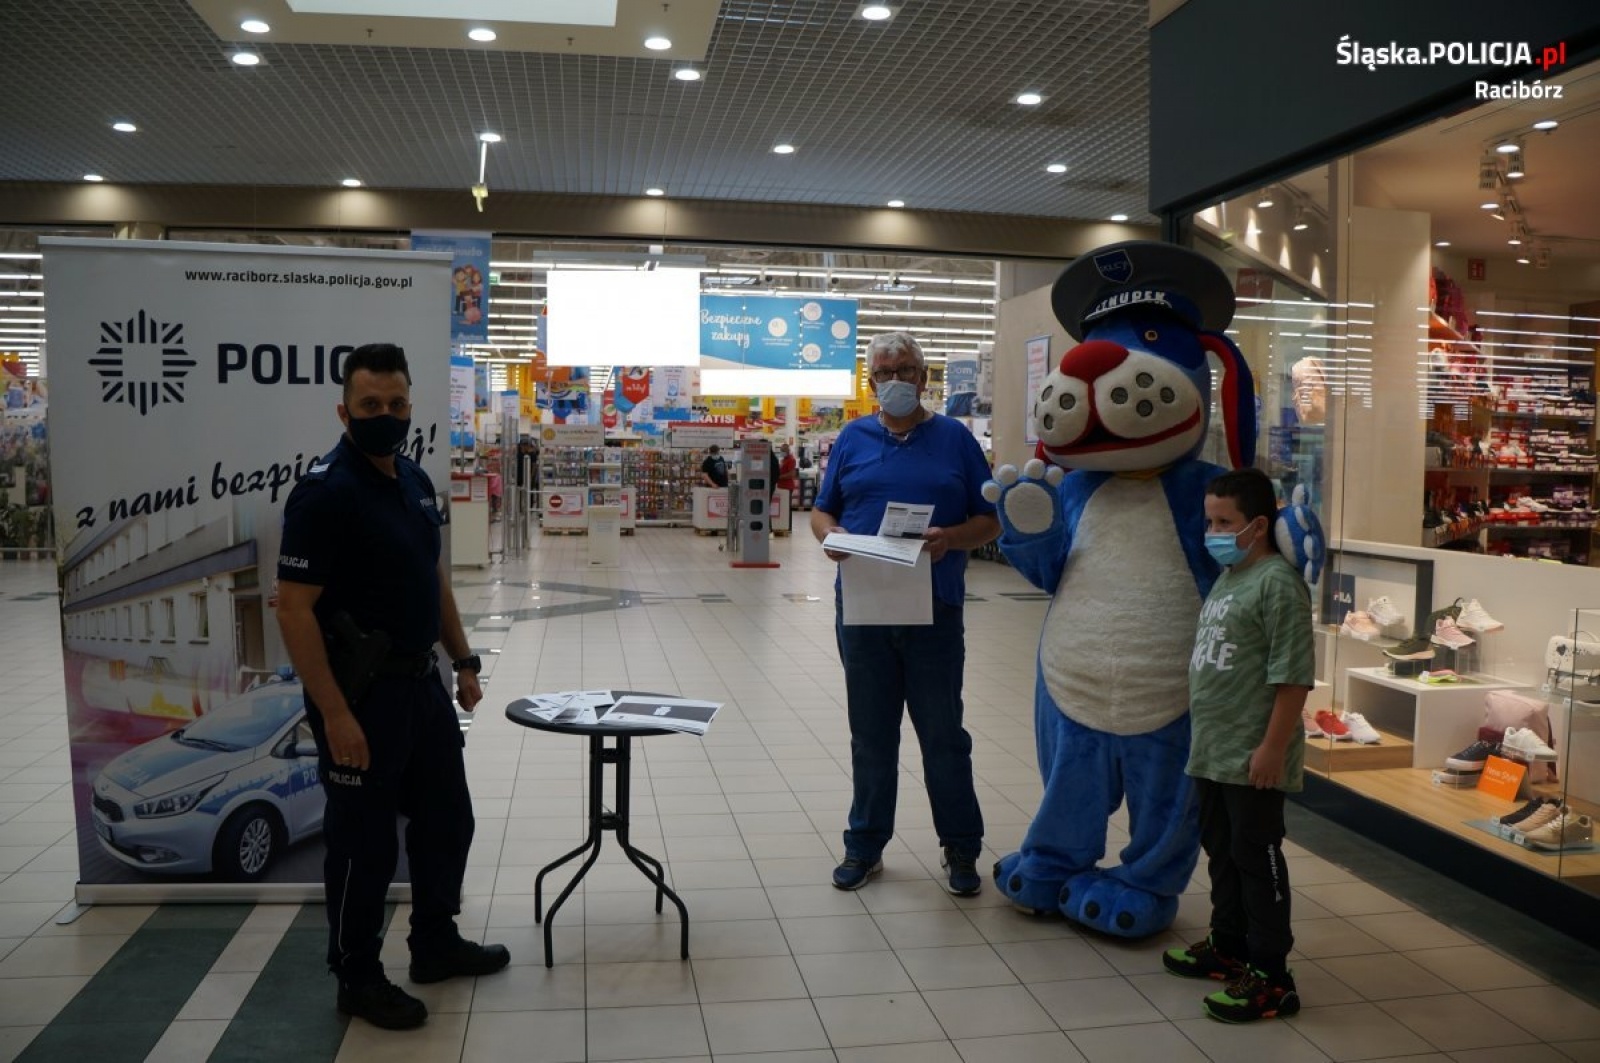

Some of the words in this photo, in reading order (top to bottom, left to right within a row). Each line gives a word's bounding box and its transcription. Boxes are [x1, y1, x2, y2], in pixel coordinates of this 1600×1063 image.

[185, 269, 413, 289] www.raciborz.slaska.policja.gov.pl
[711, 326, 750, 349] zakupy
[217, 343, 412, 386] POLIC
[76, 506, 96, 530] z
[108, 476, 200, 523] nami
